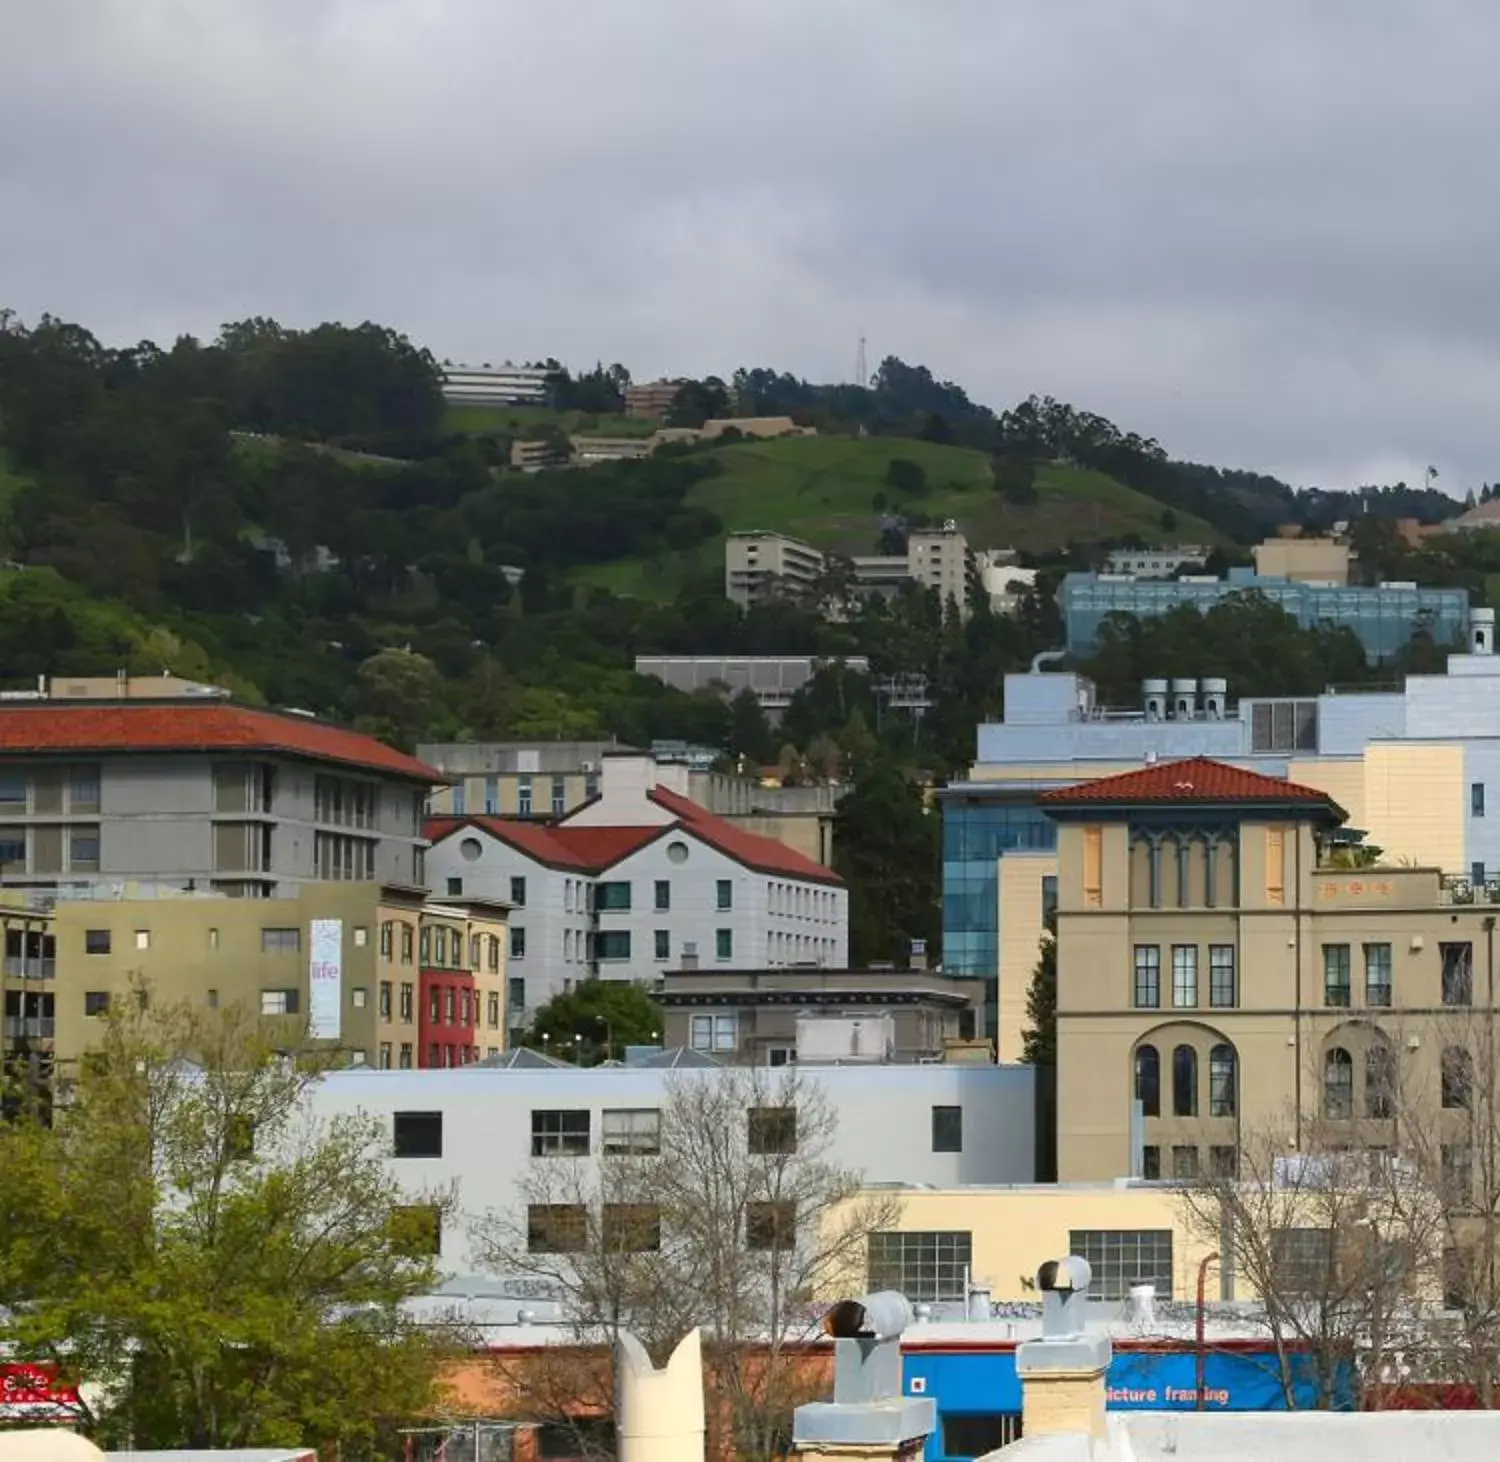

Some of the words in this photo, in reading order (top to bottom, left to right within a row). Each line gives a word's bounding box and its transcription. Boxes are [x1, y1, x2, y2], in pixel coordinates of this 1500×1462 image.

[312, 961, 339, 980] life
[3, 1368, 49, 1391] ete
[1106, 1386, 1157, 1401] icture
